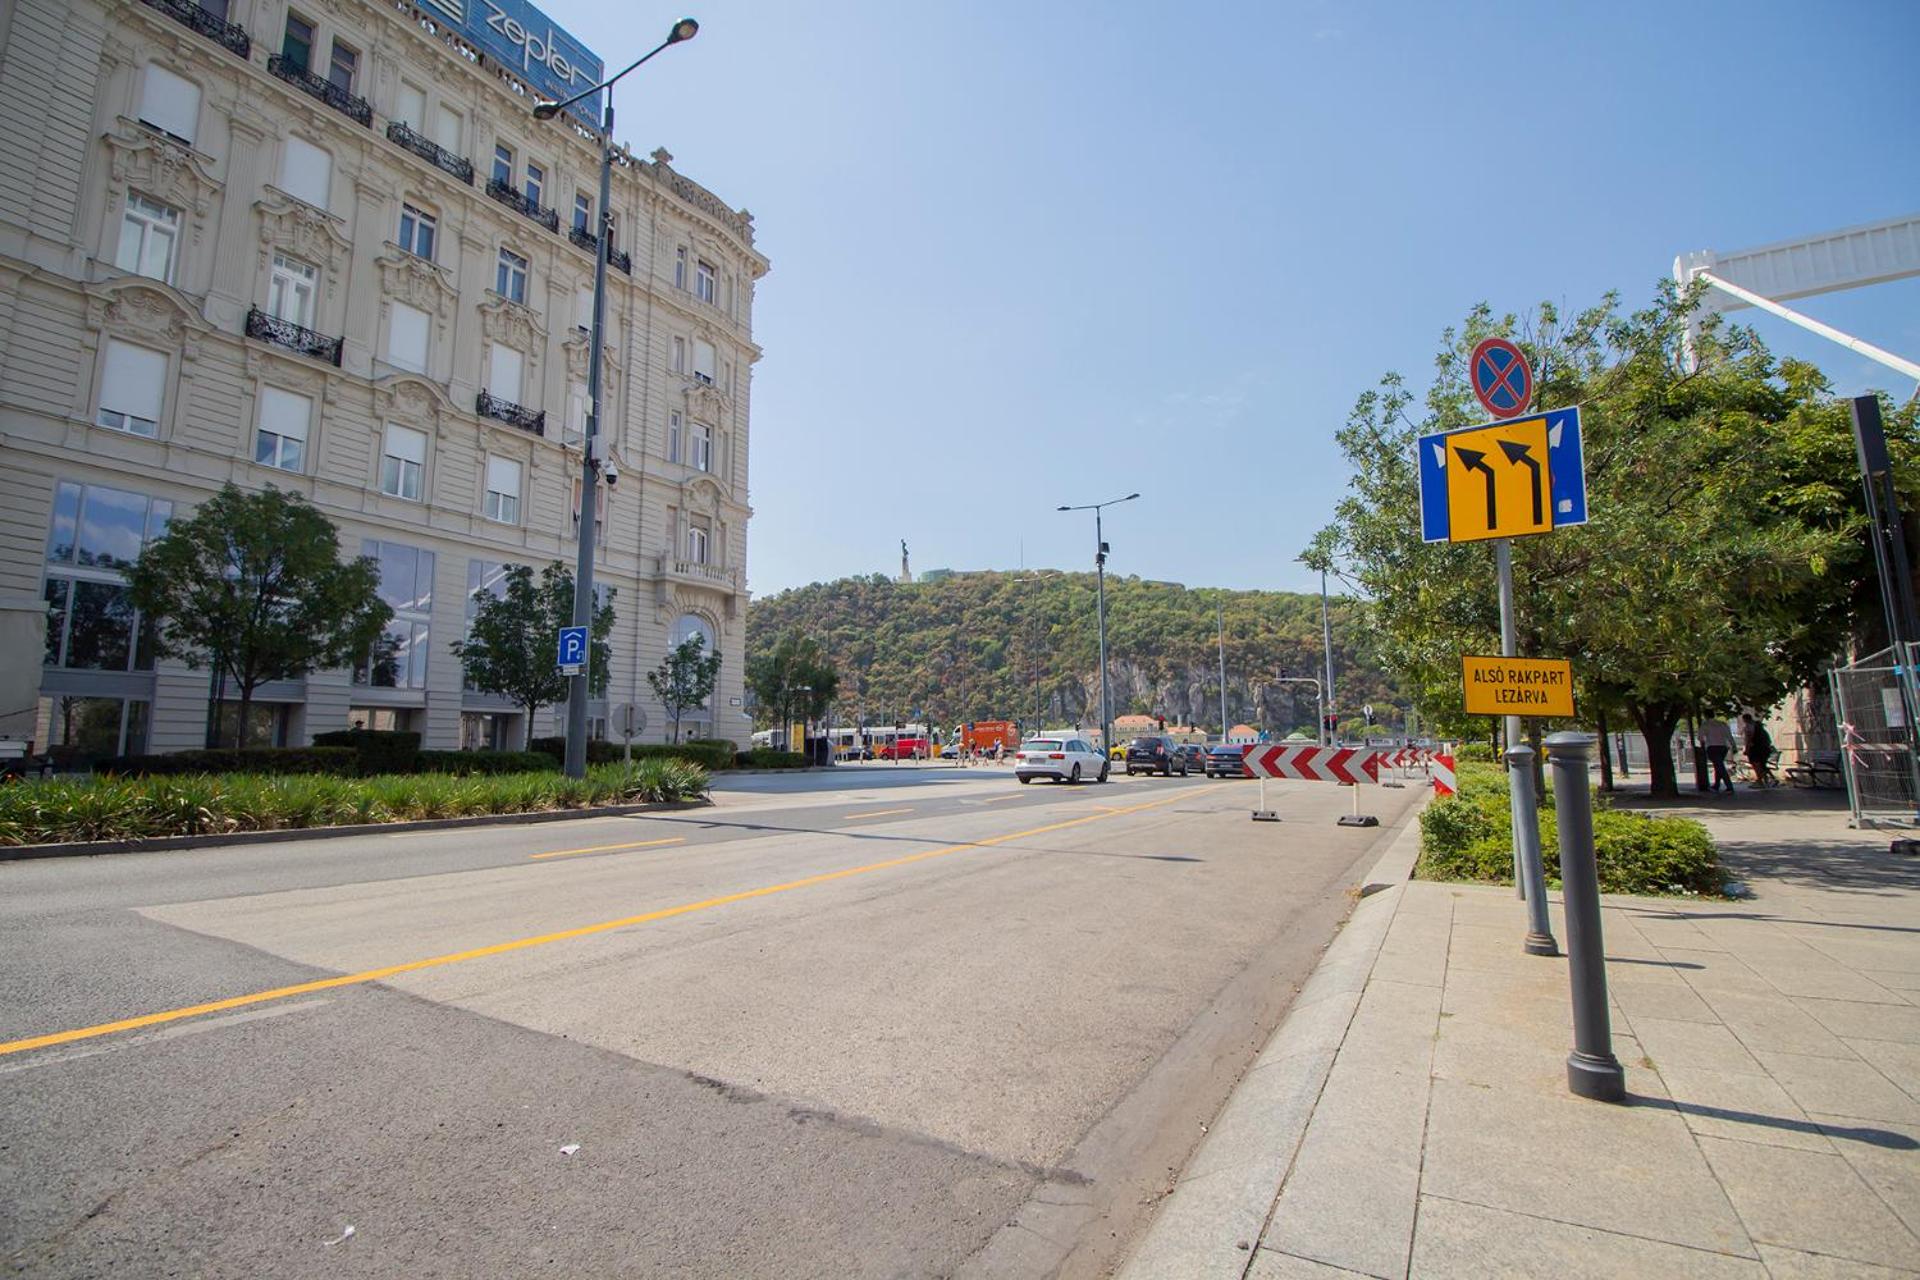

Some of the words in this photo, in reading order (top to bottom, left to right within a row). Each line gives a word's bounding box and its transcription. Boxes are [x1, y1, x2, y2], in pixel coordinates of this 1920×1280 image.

[567, 639, 579, 660] P
[1474, 666, 1504, 683] ALSÓ
[1508, 669, 1564, 685] RAKPART
[1495, 686, 1548, 704] LEZÁRVA
